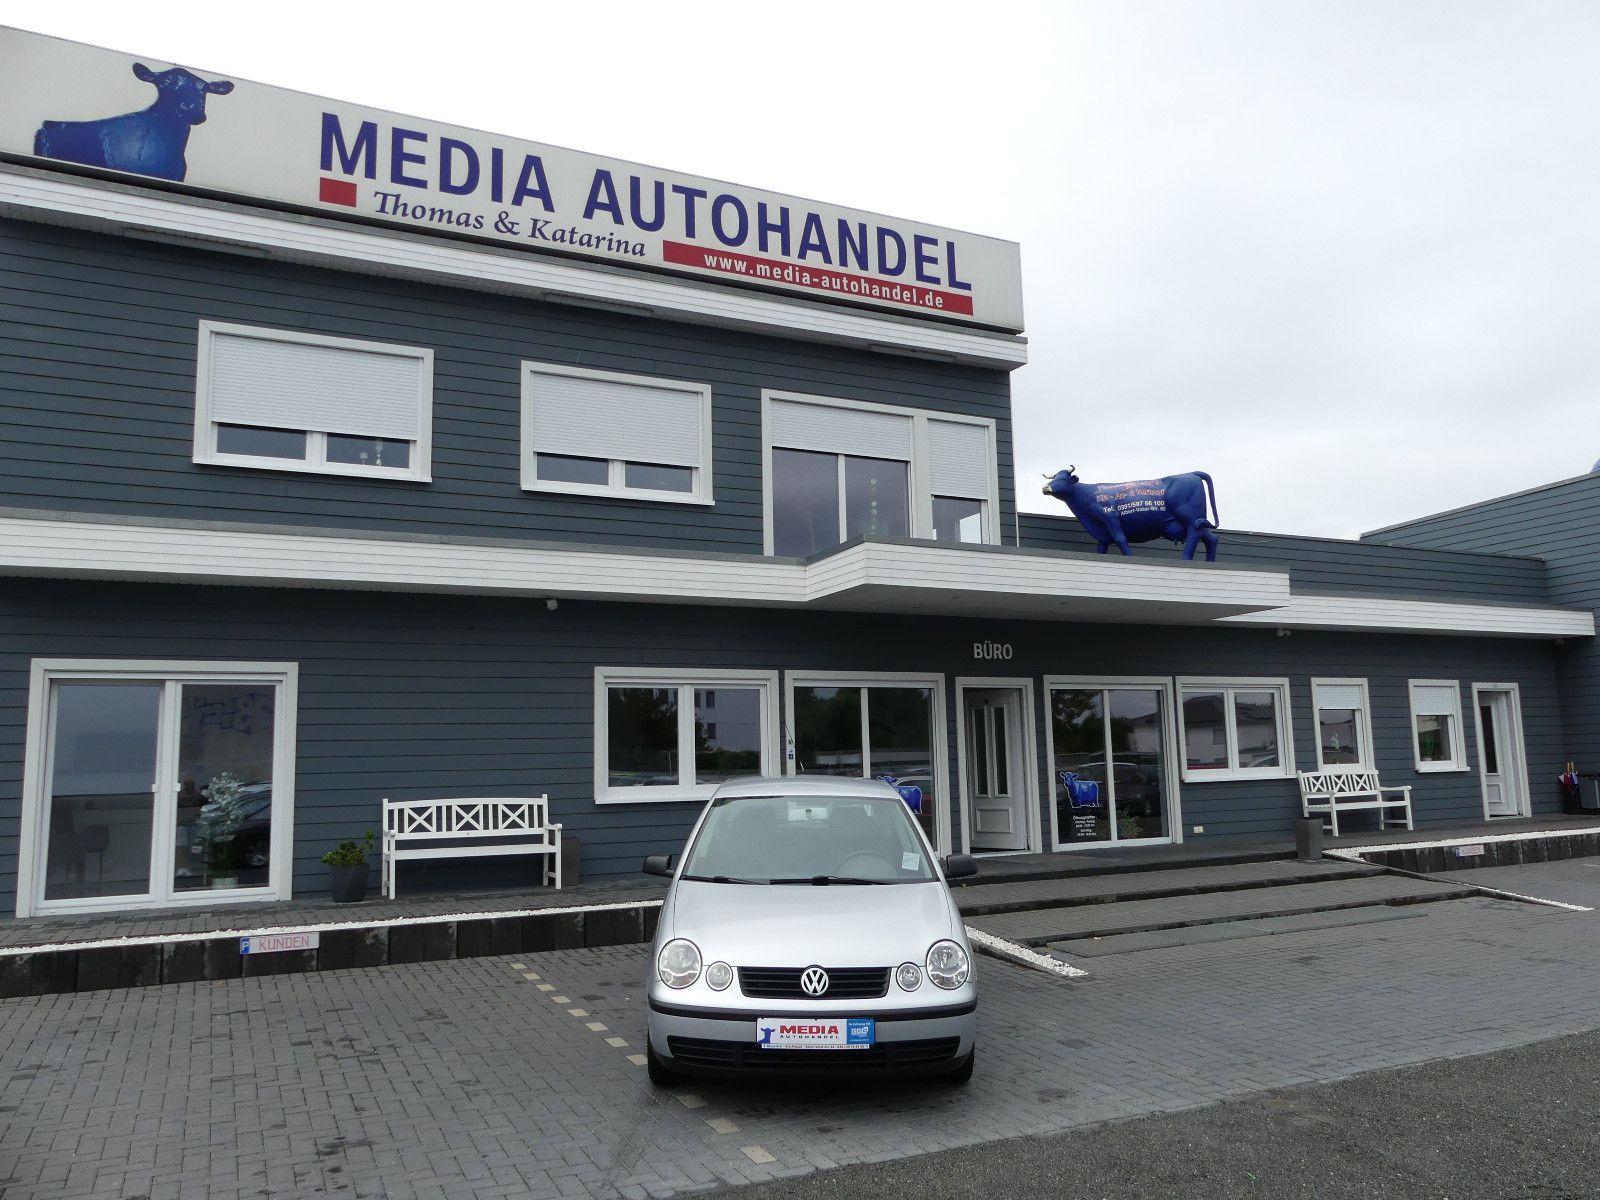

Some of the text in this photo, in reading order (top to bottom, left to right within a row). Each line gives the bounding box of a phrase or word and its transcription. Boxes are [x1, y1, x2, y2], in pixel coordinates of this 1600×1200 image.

[320, 112, 972, 292] MEDIA AUTOHANDEL
[373, 190, 646, 257] Thomas & Katarina
[704, 251, 944, 309] www.media-autohandel.de
[973, 640, 1013, 660] BÜRO
[259, 936, 309, 950] KUNDEN
[780, 1026, 839, 1034] MEDIA
